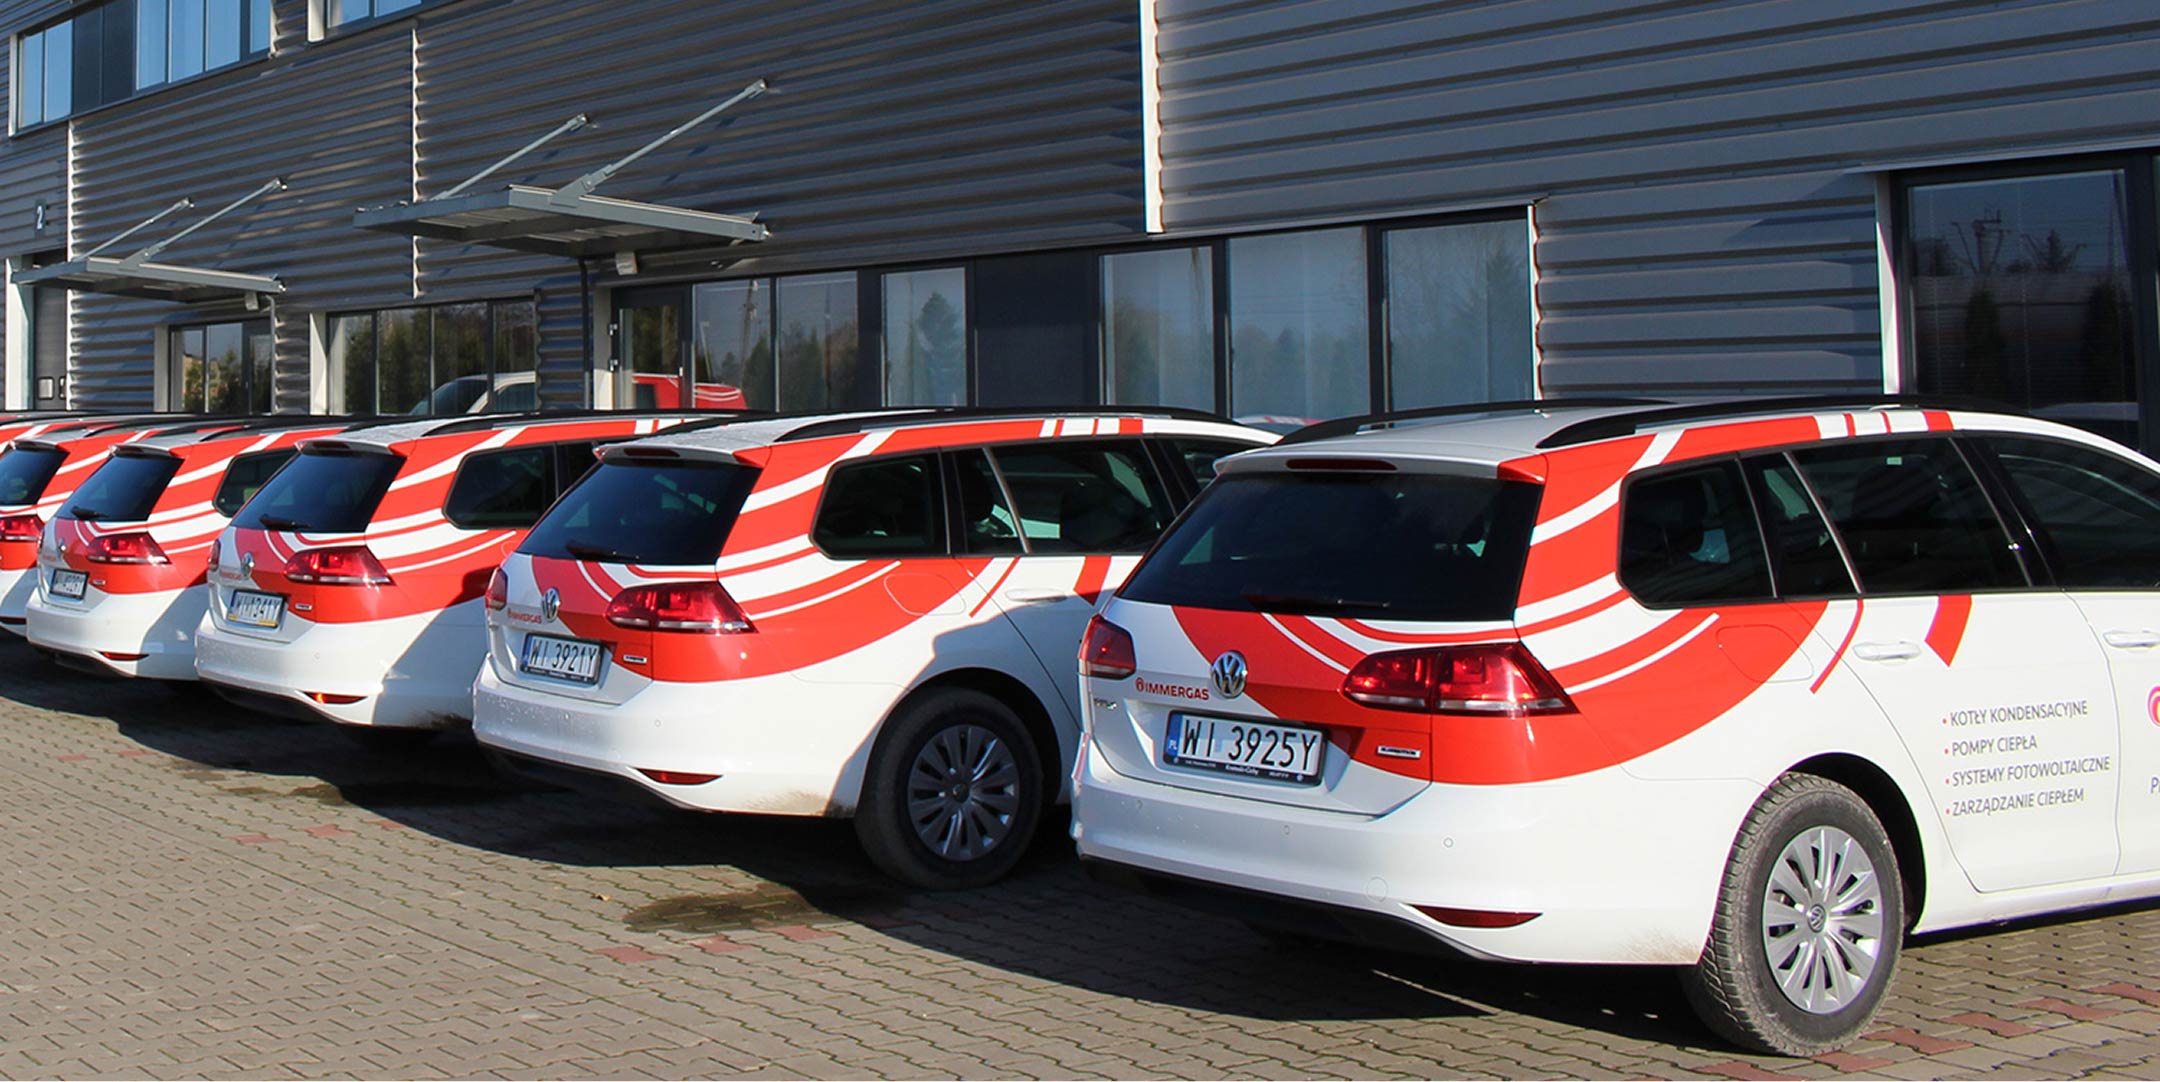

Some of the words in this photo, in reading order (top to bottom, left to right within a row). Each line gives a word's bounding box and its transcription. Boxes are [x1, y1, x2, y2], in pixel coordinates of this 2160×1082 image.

[36, 205, 43, 230] 2
[530, 638, 549, 667] WI
[552, 643, 597, 676] 3921Y
[1145, 683, 1209, 700] IMMERGAS
[1950, 709, 1987, 727] KOTŁY
[1990, 700, 2088, 723] KONDENSACYJNE
[1183, 719, 1215, 757] WI
[1228, 725, 1317, 771] 3925Y
[1952, 738, 1994, 757] POMPY
[1997, 735, 2038, 752] CIEPŁA
[1952, 767, 2005, 787] SYSTEMY
[2007, 756, 2110, 781] FOTOWOLTAICZNE
[1952, 793, 2034, 816] ZARZĄDZANIE
[2037, 787, 2084, 806] CIEPŁEM
